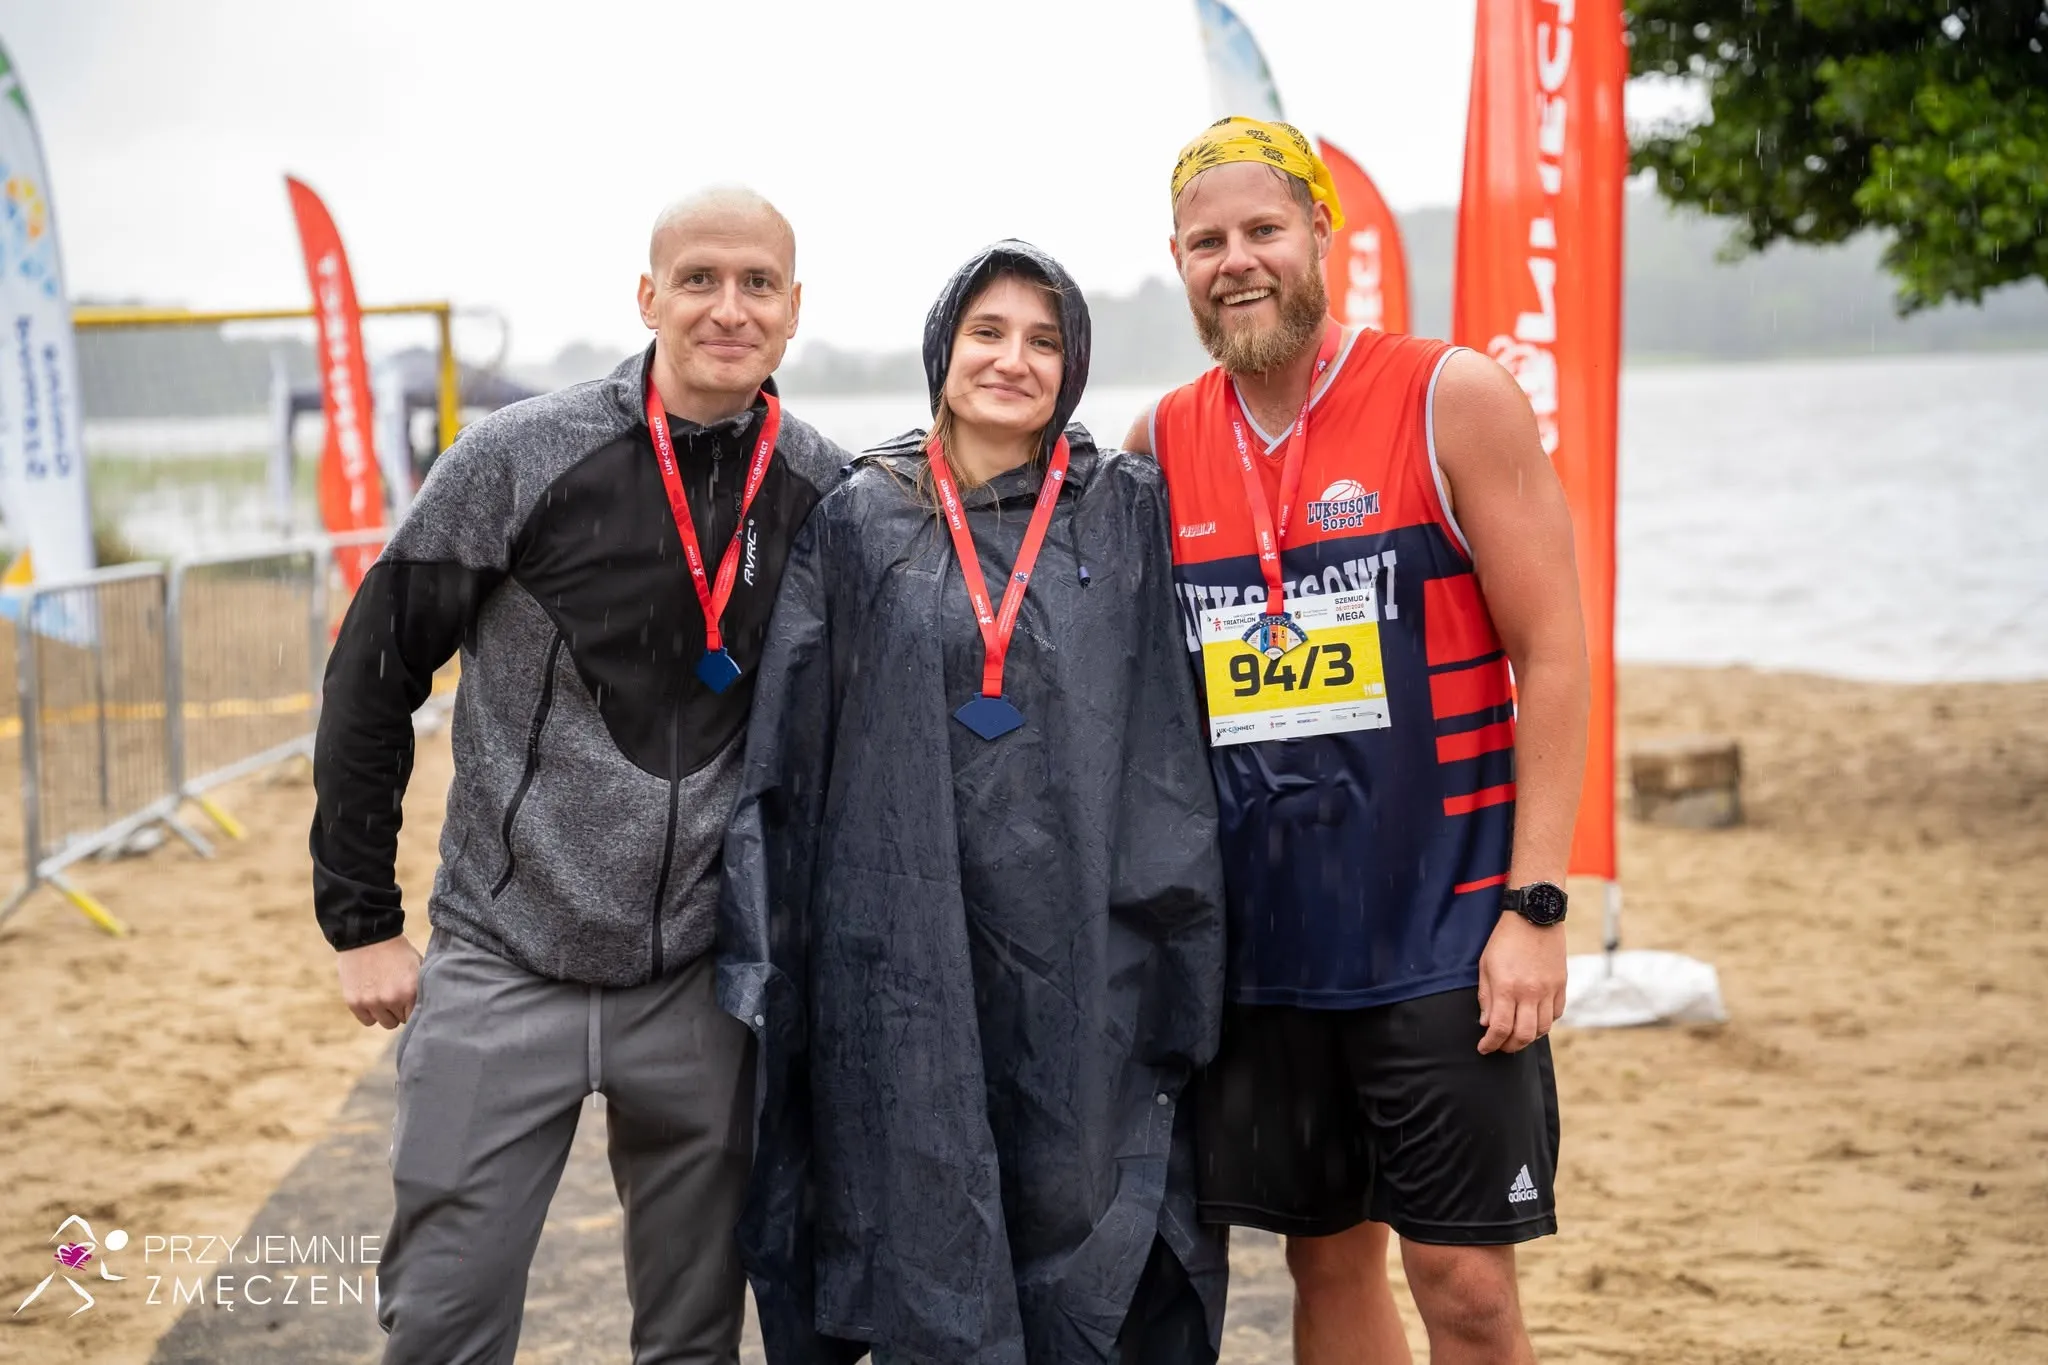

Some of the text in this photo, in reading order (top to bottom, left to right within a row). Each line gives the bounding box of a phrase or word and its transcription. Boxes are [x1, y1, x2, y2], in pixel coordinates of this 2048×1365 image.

[653, 416, 674, 476] LUK-CONNECT
[1232, 421, 1252, 472] LUK-CONNECT
[745, 440, 769, 499] LUK-CONNECT
[940, 479, 962, 530] LUK-CONNECT
[1307, 491, 1380, 523] LUKSUSOWI
[1322, 513, 1364, 532] SOPOT
[743, 527, 757, 586] RVRC
[975, 593, 986, 615] STONE
[1334, 595, 1364, 604] SZEMUD
[1222, 616, 1256, 626] TRIATHLON
[1336, 610, 1366, 622] MEGA
[1229, 642, 1355, 697] 94/3
[1508, 1188, 1538, 1203] adidas
